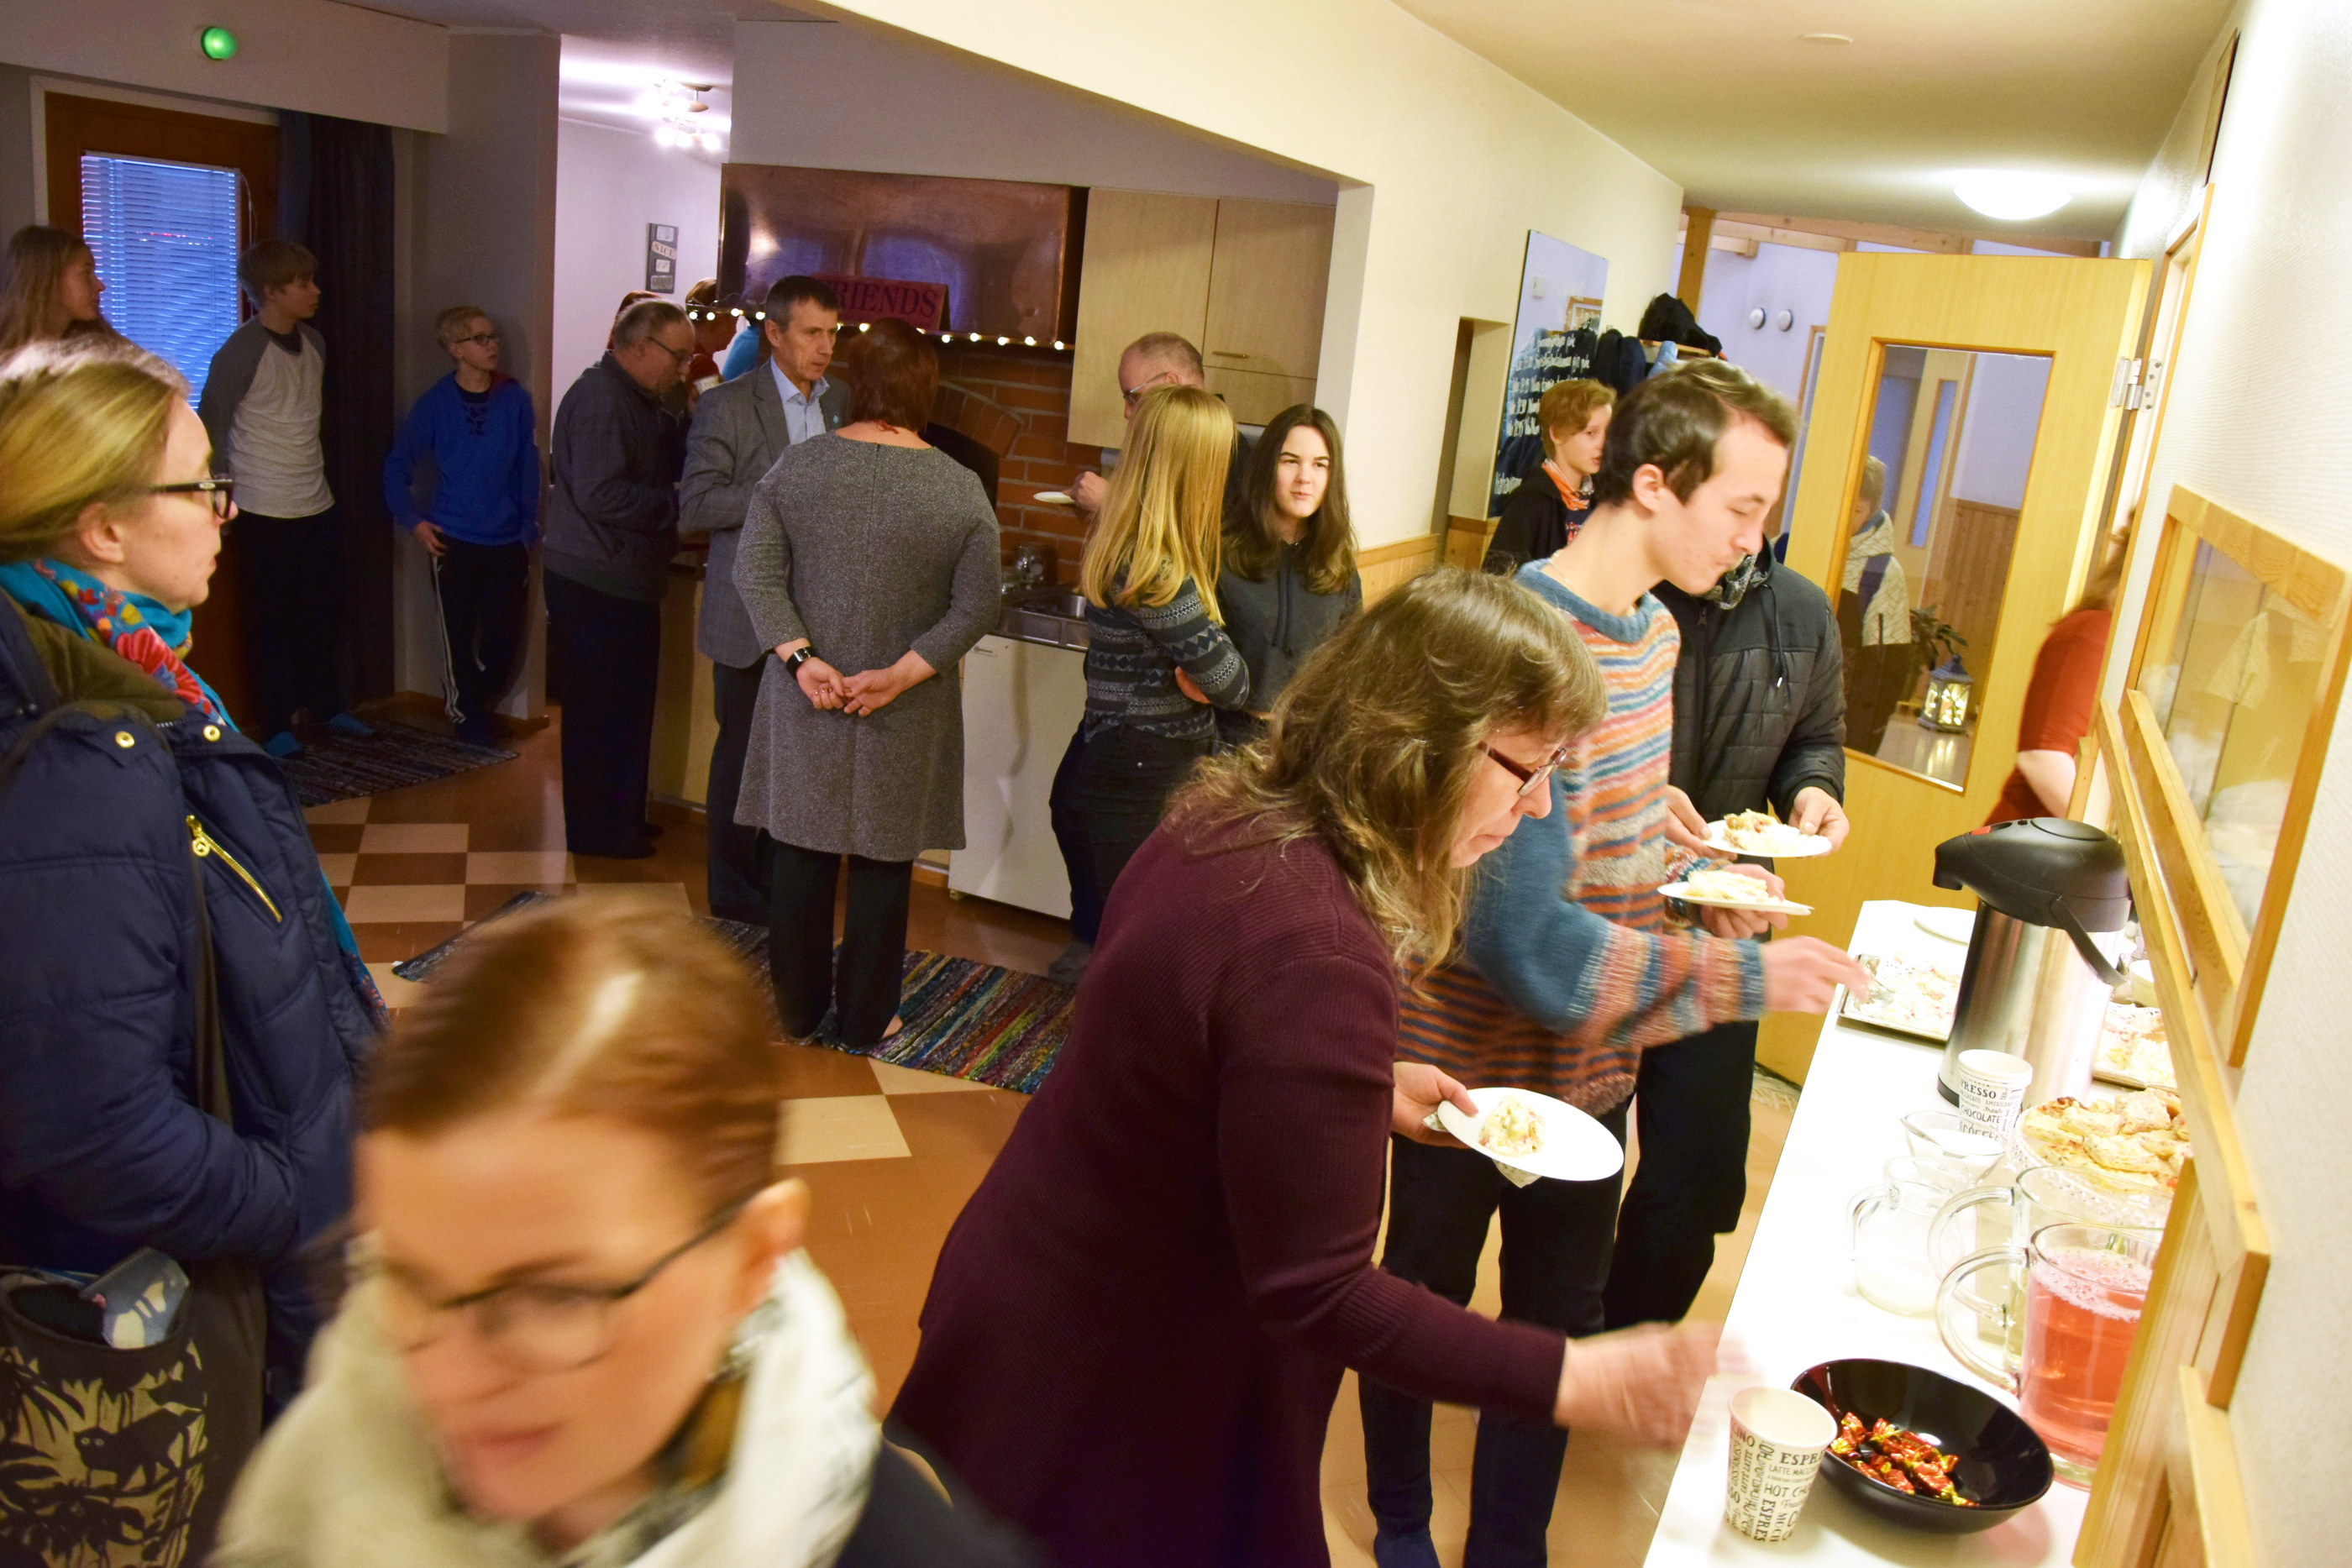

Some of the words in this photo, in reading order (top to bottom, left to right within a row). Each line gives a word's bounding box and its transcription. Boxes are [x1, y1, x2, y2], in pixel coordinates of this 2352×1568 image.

[828, 281, 937, 317] RIENDS
[1961, 1104, 2001, 1124] CHOCOLATE
[1769, 1464, 1792, 1475] LATTE
[1764, 1483, 1789, 1497] HOT
